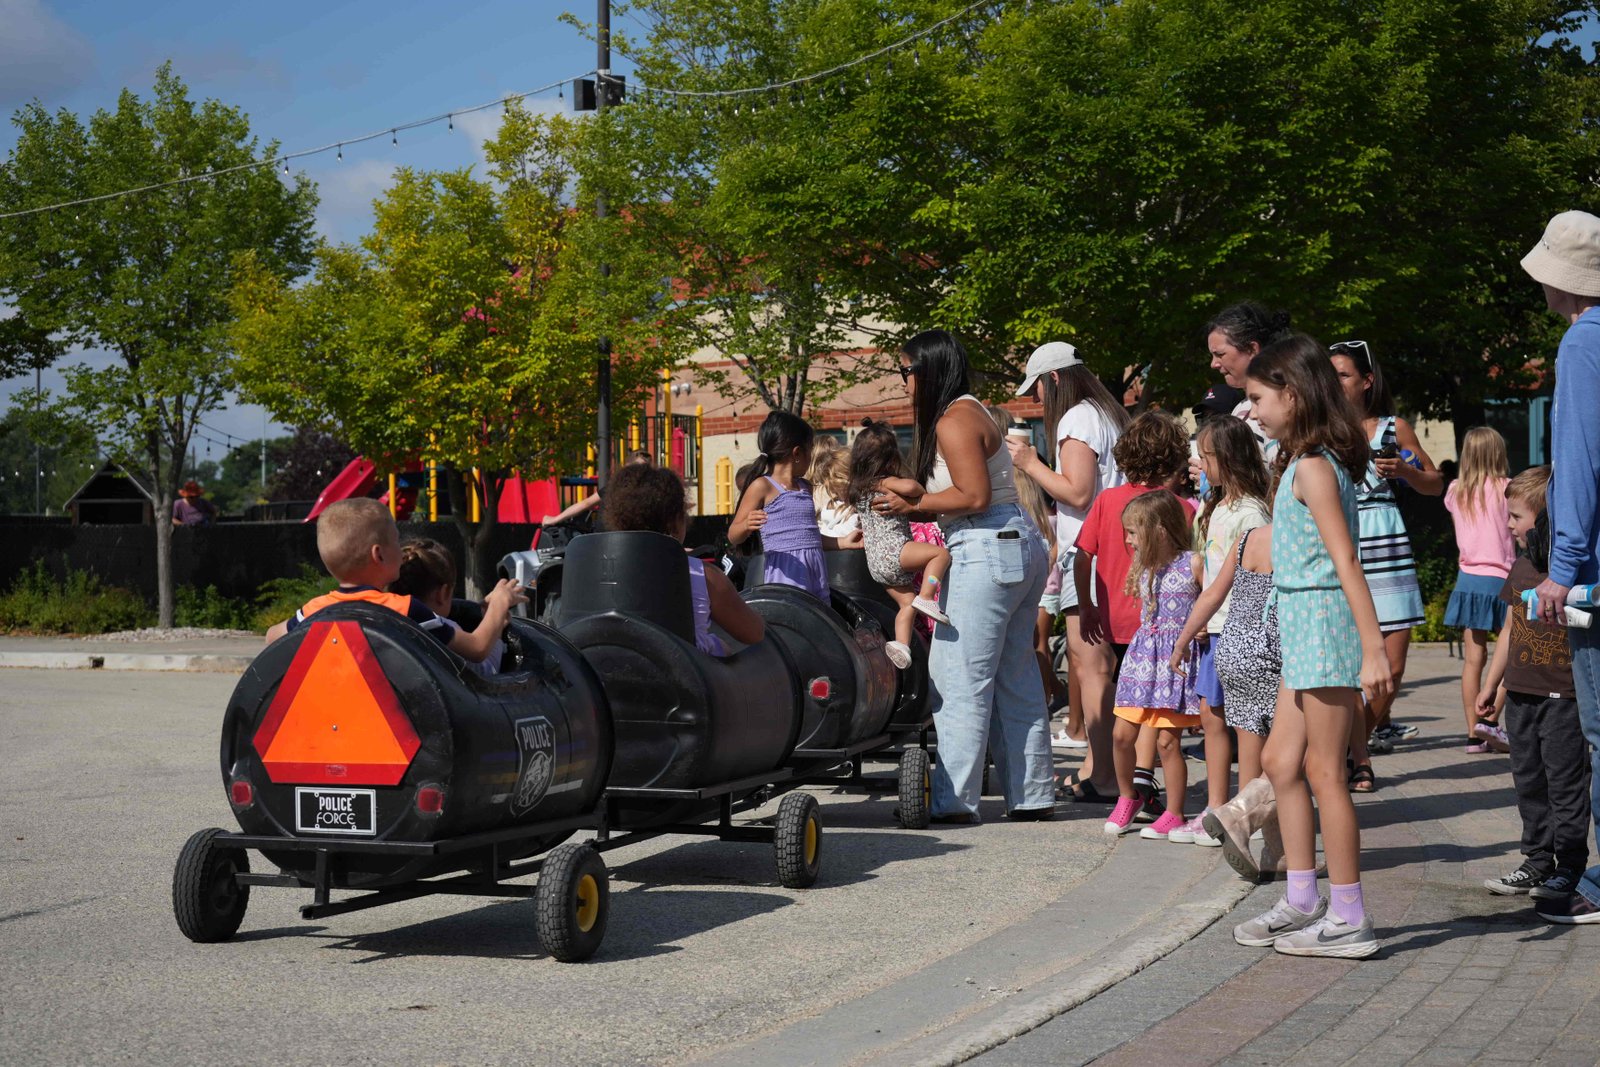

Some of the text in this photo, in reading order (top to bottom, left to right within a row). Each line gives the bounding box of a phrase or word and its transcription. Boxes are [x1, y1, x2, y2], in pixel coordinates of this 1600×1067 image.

[520, 724, 551, 751] POLICE
[319, 796, 353, 812] POLICE
[316, 811, 356, 825] FORCE
